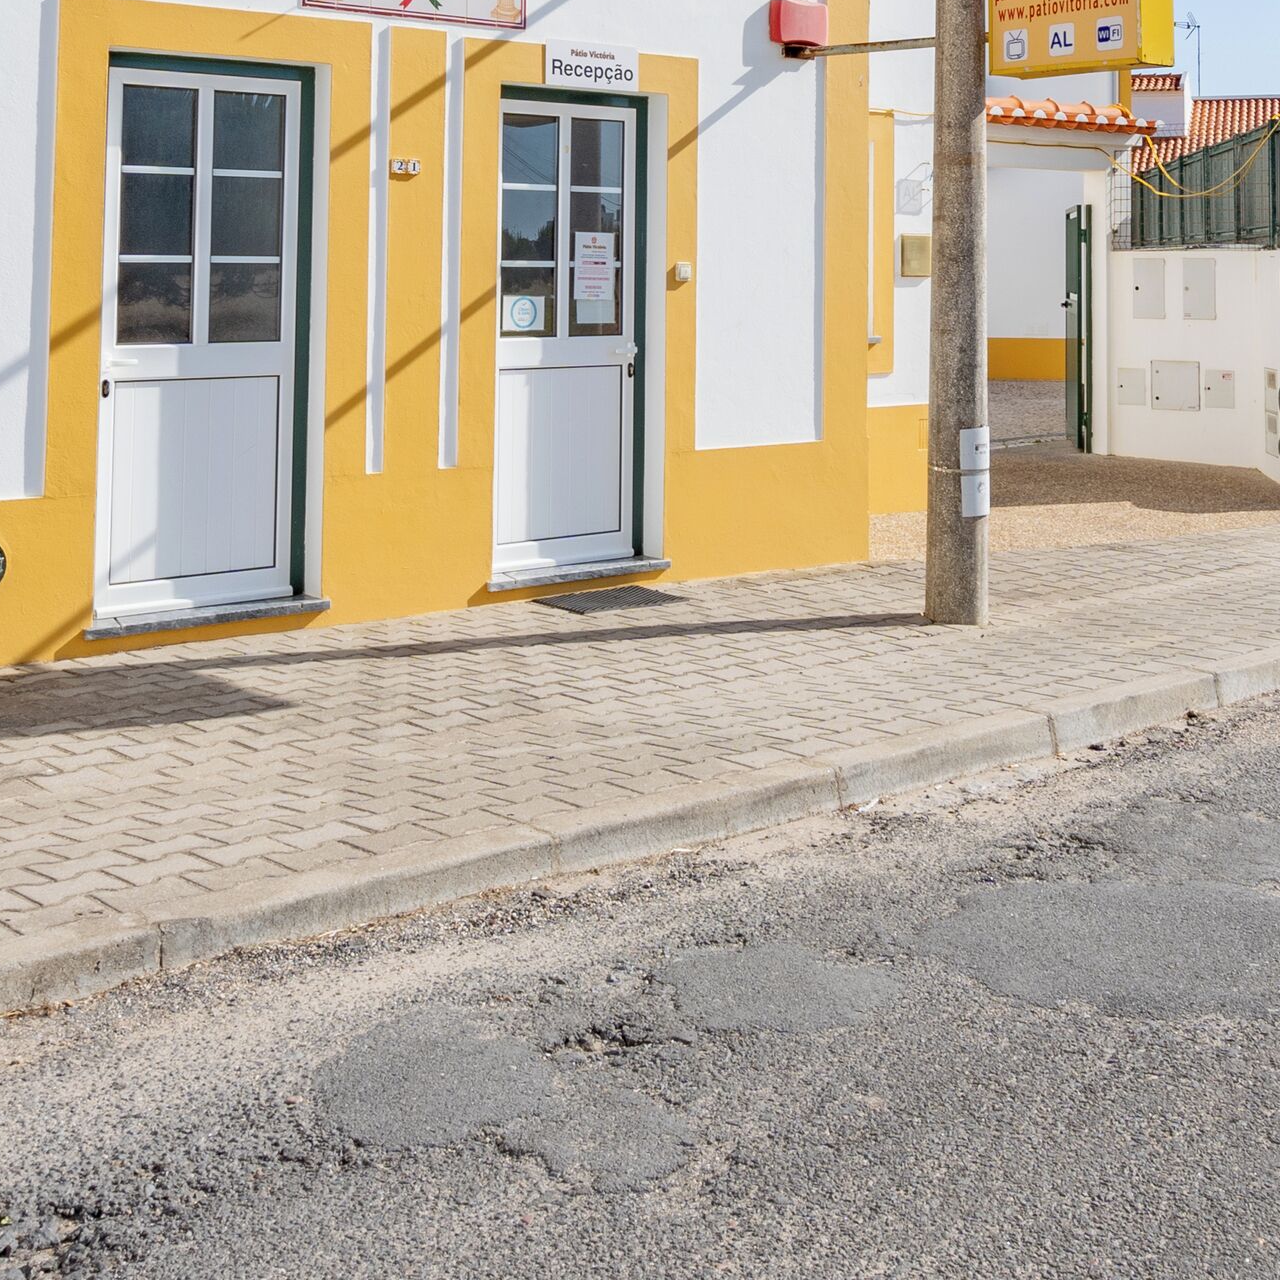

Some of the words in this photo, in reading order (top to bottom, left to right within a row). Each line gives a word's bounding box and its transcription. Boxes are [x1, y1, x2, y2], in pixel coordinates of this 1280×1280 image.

[1050, 31, 1073, 49] AL
[570, 48, 588, 58] Pátio
[589, 50, 615, 60] Victória
[551, 58, 634, 85] Recepção
